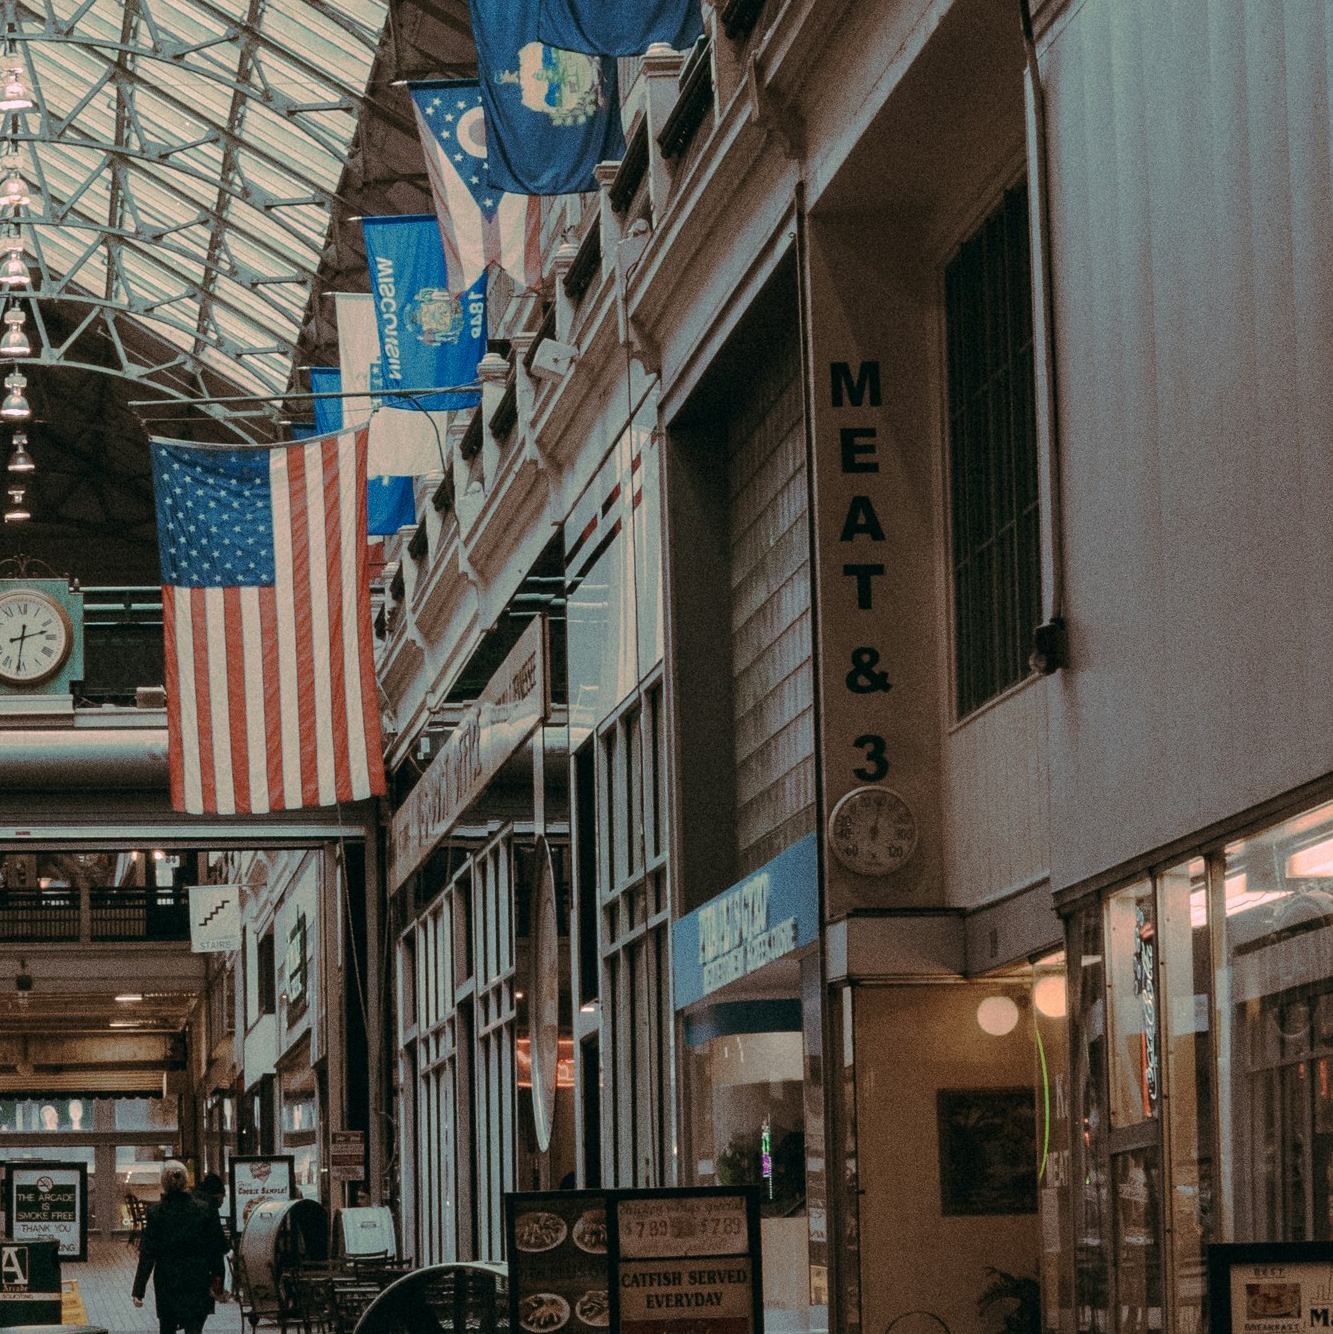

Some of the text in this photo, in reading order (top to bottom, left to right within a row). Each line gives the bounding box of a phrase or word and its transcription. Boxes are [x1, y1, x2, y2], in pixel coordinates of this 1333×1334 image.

[830, 360, 892, 783] MEAT & 3
[200, 940, 231, 950] STAIRS
[17, 1193, 75, 1202] THE ARCADE
[41, 1202, 50, 1211] IS
[18, 1211, 75, 1220] SMOKE FREE
[21, 1224, 71, 1232] THANK YOU
[1253, 1267, 1285, 1277] BEST
[621, 1268, 748, 1289] CATFISH SERVED
[646, 1291, 723, 1309] EVERYDAY
